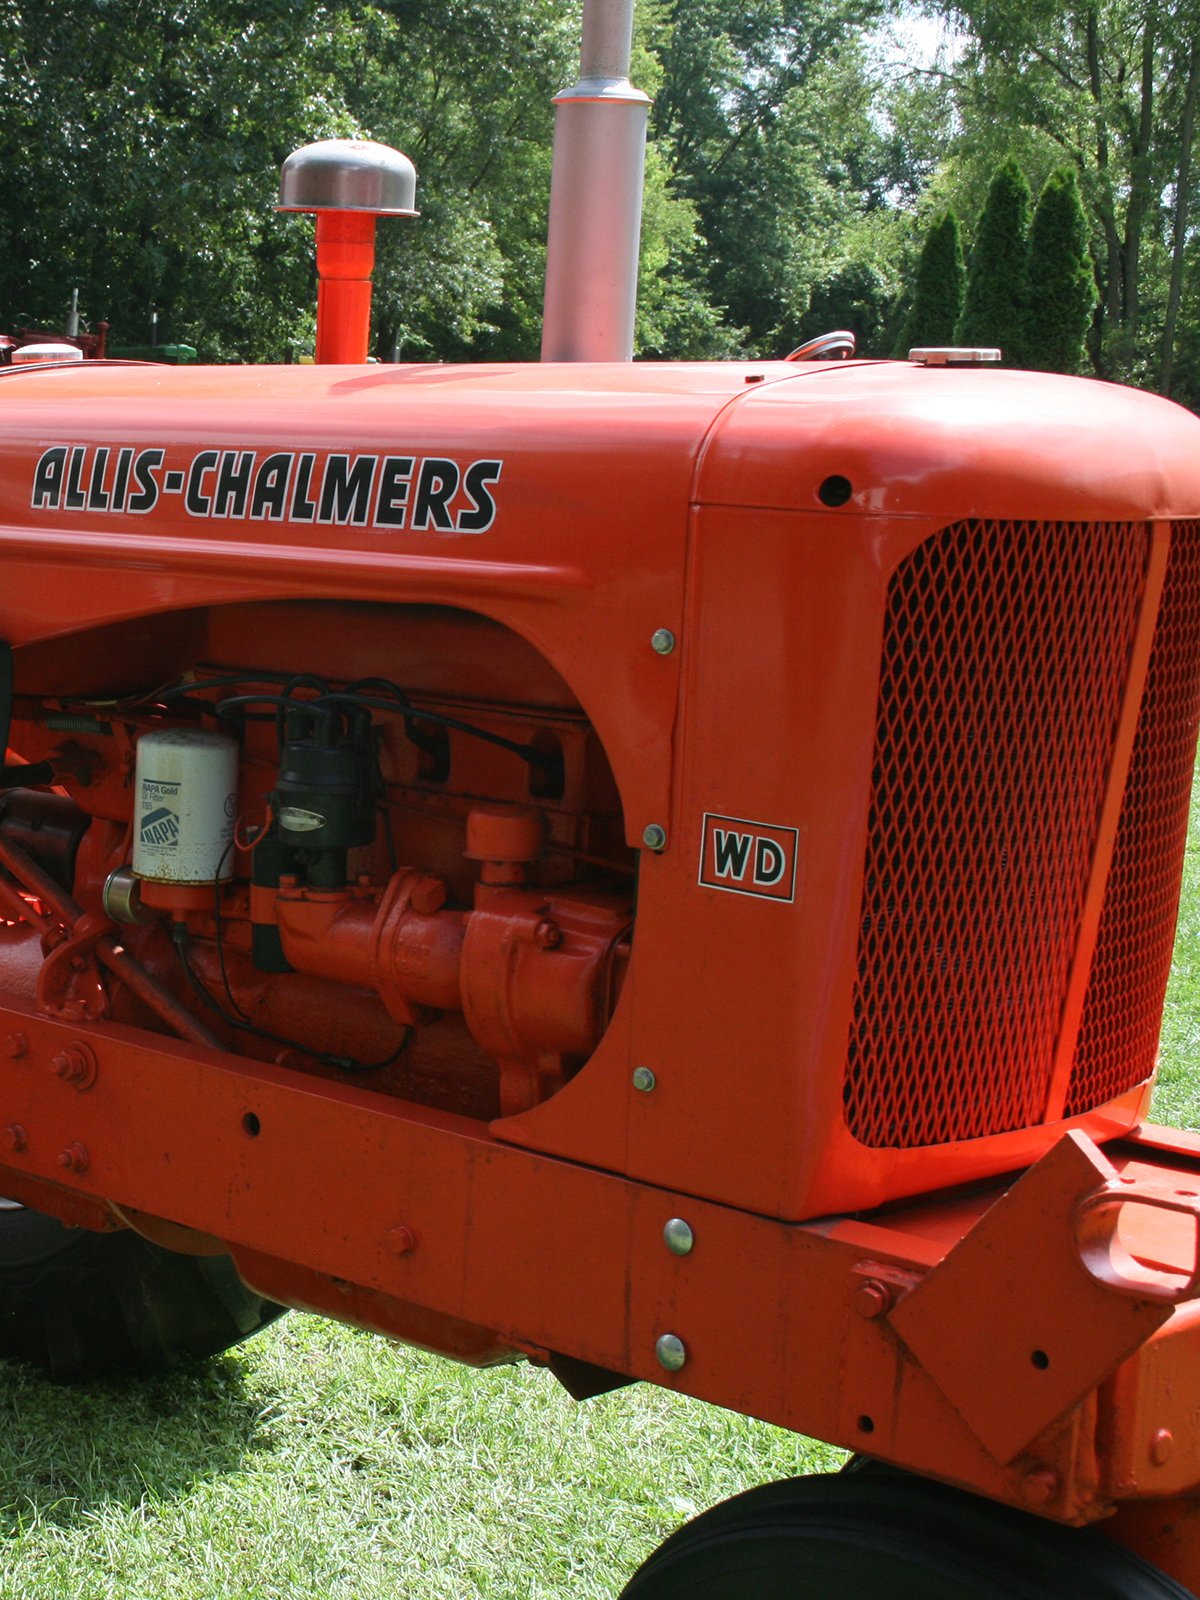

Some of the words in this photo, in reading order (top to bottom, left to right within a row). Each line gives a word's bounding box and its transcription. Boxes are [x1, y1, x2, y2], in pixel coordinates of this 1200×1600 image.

[30, 446, 503, 535] ALLIS-CHALMERS
[143, 783, 160, 794] NAPA
[160, 786, 178, 795] Gold
[149, 792, 165, 802] Filter
[143, 818, 179, 844] NAPA
[713, 828, 786, 886] WD
